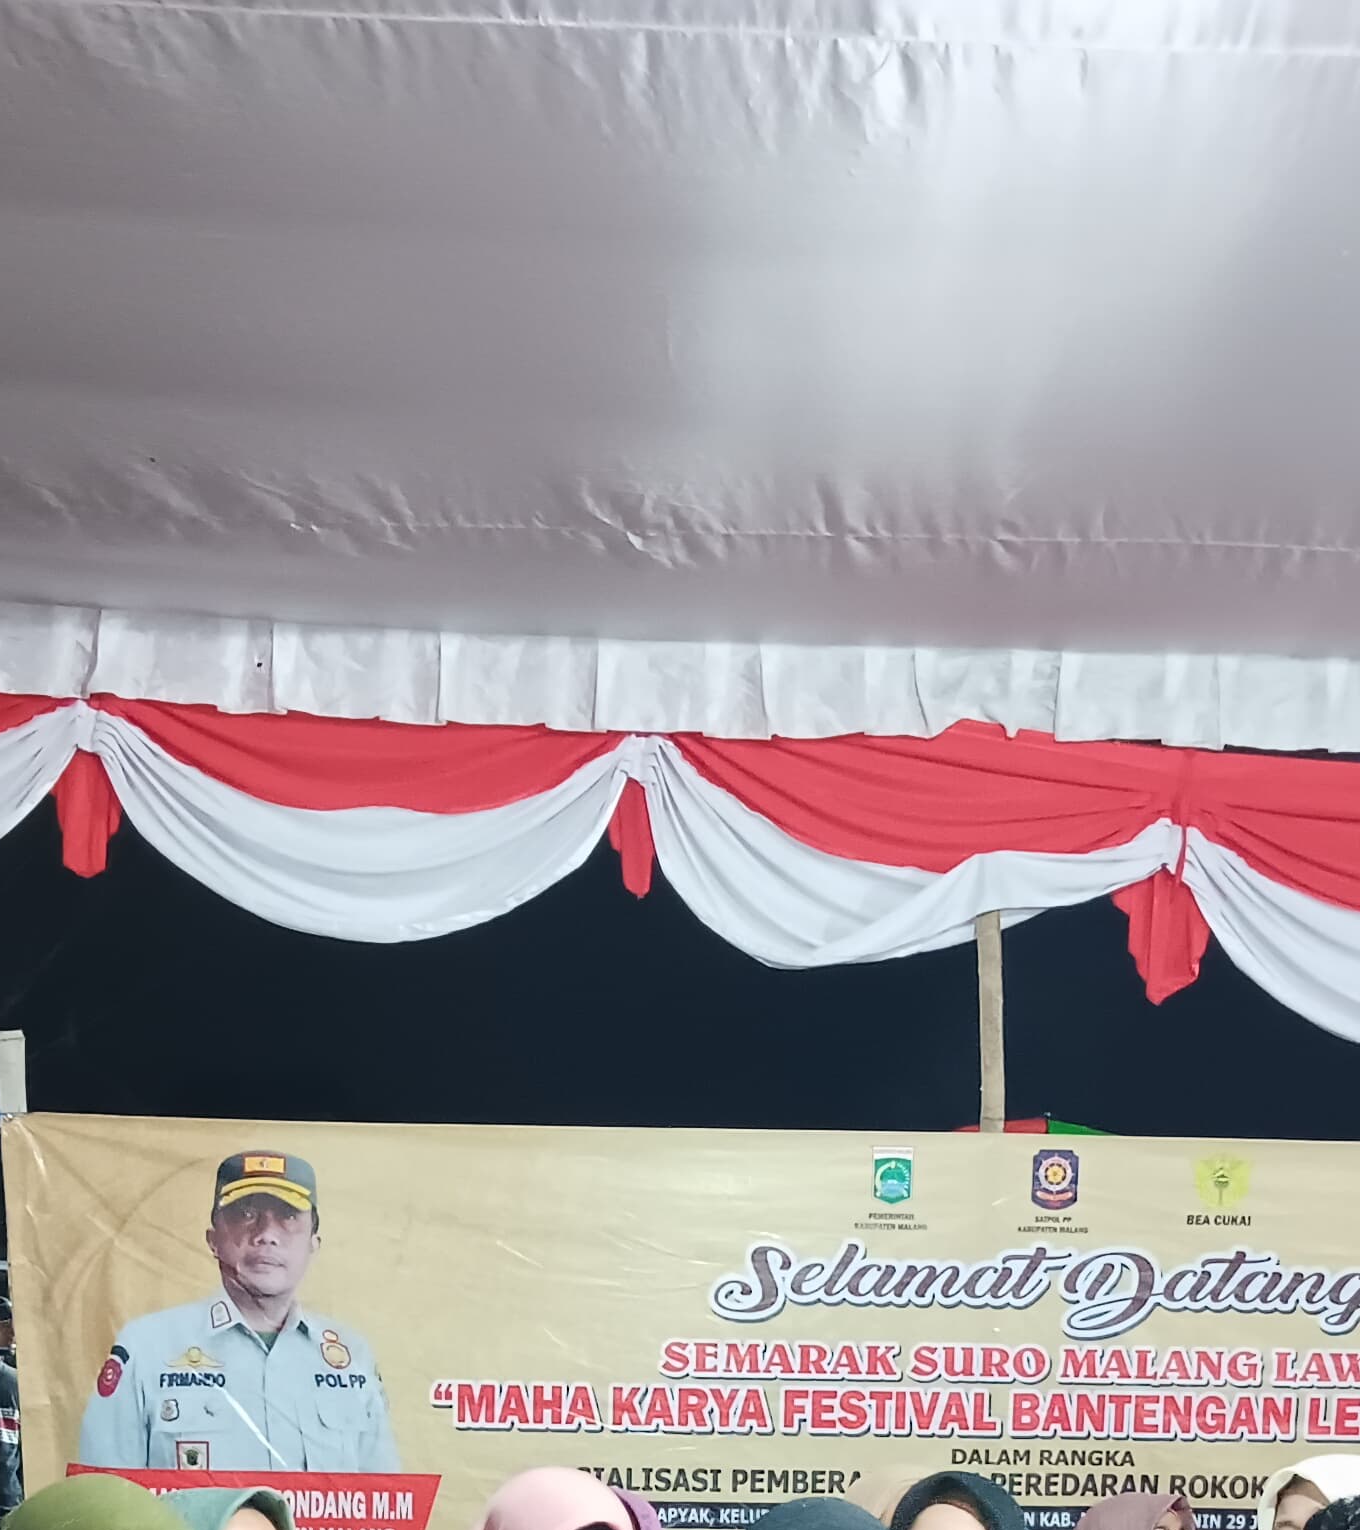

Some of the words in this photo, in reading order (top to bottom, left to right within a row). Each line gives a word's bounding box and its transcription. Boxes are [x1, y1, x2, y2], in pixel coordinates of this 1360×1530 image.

[1187, 1214, 1211, 1226] BEA
[1215, 1215, 1252, 1227] CUKAI
[717, 1242, 1072, 1318] Selamat
[660, 1342, 900, 1378] SEMARAK
[909, 1345, 1046, 1381] SURO
[1060, 1349, 1260, 1383] MALANG
[160, 1371, 226, 1388] FIRMANDO
[315, 1374, 347, 1388] POL
[349, 1374, 367, 1389] PP
[613, 1385, 769, 1429] KARYA
[784, 1390, 999, 1432] FESTIVAL
[1013, 1394, 1290, 1436] BANTENGAN
[951, 1449, 1031, 1466] DALAM
[1039, 1449, 1135, 1467] RANGKA
[580, 1467, 721, 1492] IALISASI
[732, 1470, 862, 1494] PEMBER
[990, 1473, 1159, 1497] PEREDARAN
[372, 1491, 413, 1521] M.M
[1039, 1511, 1076, 1528] KAB.
[1225, 1514, 1246, 1530] 29
